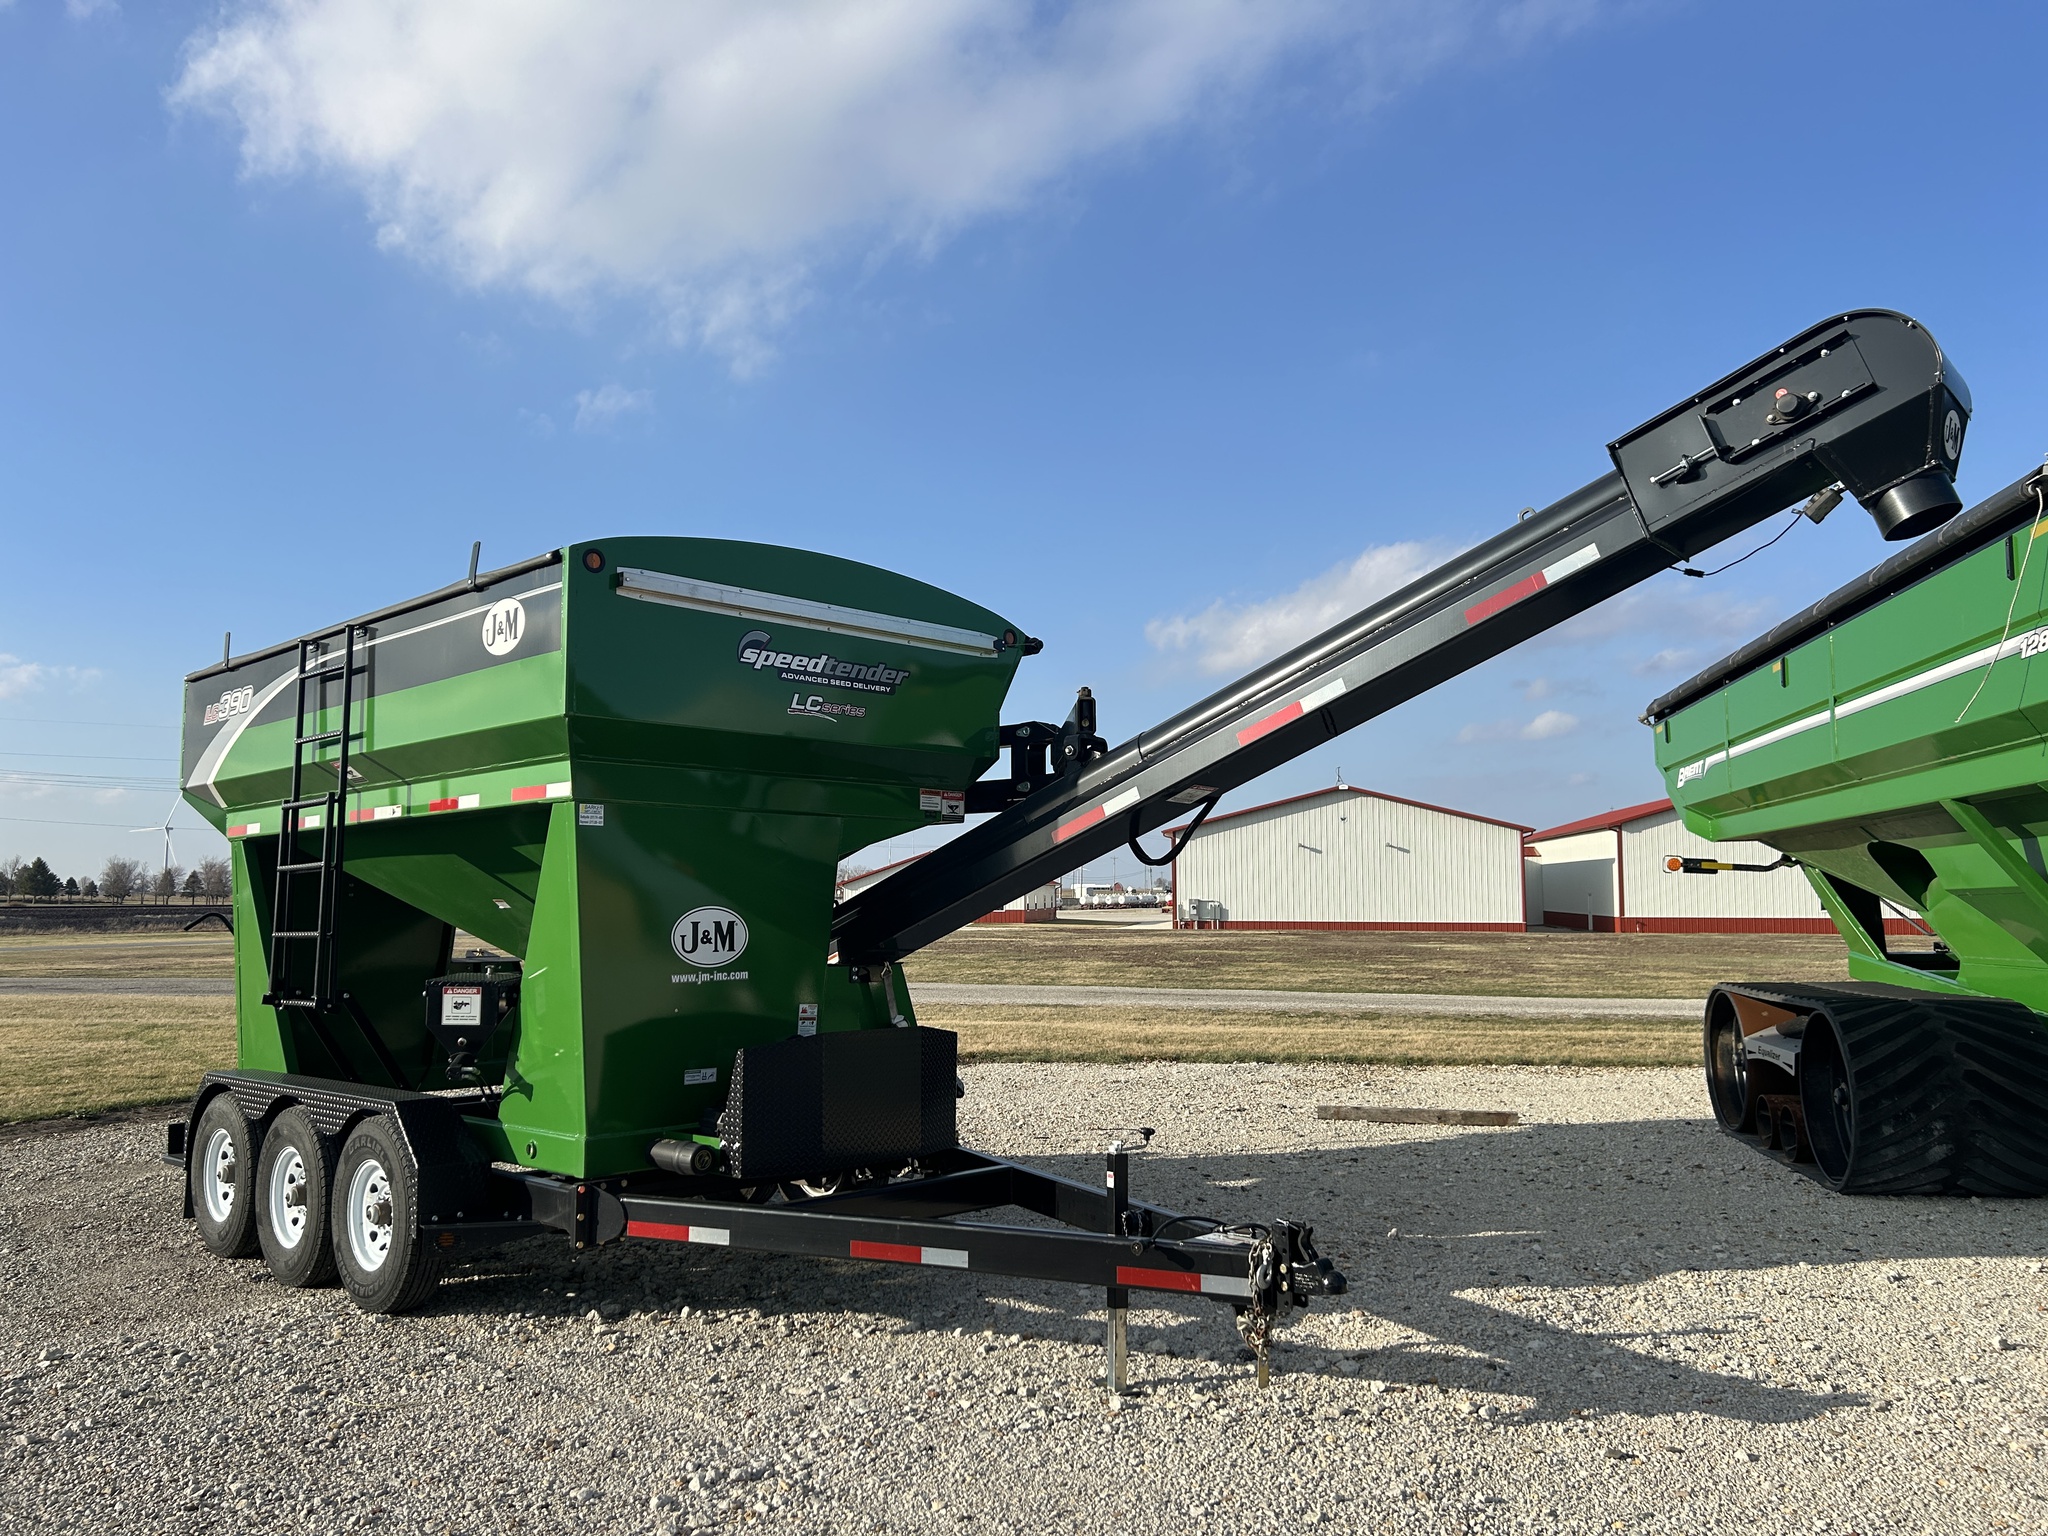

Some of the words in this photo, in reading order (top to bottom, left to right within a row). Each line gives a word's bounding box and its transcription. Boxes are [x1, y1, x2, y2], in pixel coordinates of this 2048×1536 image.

[486, 606, 519, 647] J&M
[781, 672, 829, 685] ADVANCED
[830, 678, 852, 688] SEED
[853, 682, 892, 693] DELIVERY
[680, 920, 737, 954] J&M
[671, 970, 749, 985] www.jm-inc.com
[1757, 1045, 1781, 1061] Equalizer
